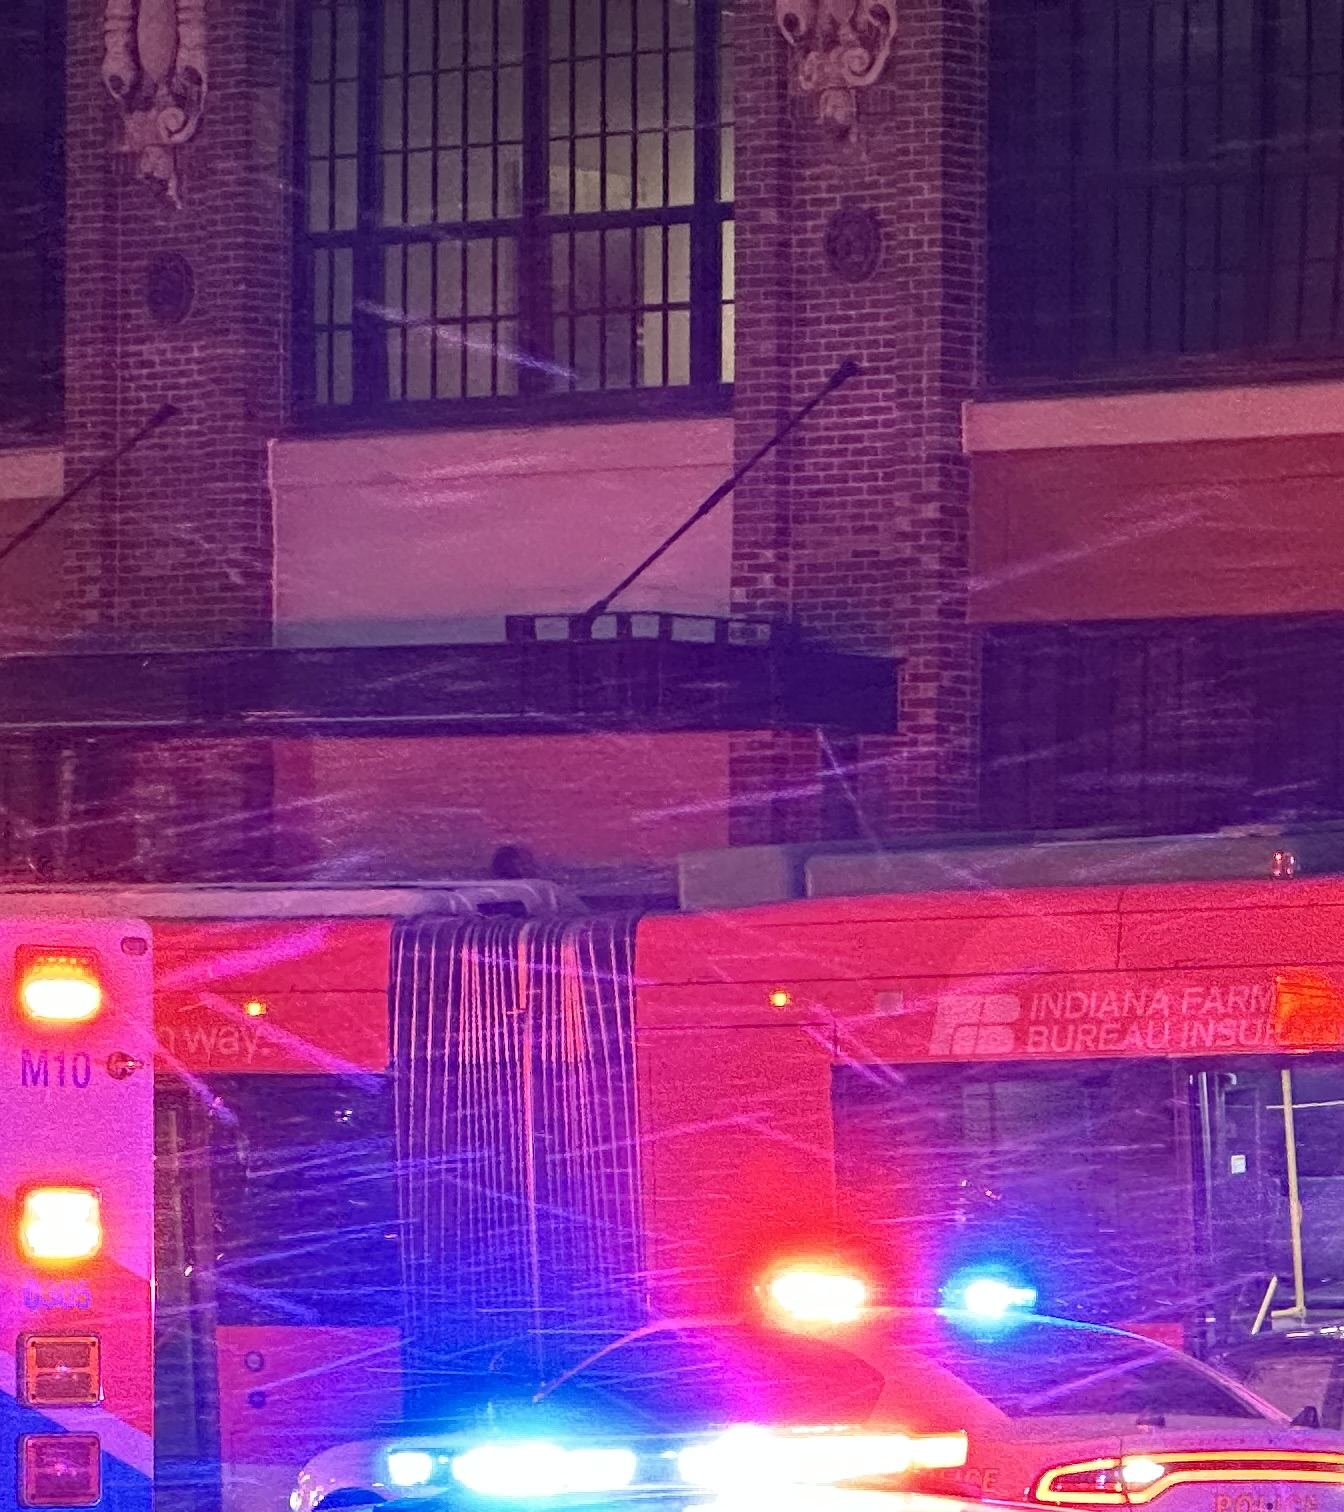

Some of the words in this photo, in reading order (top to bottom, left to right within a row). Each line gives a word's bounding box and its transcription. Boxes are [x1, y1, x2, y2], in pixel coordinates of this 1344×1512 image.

[1029, 989, 1170, 1021] INDIANA
[1028, 1022, 1170, 1053] BUREAU
[21, 1050, 91, 1088] M10
